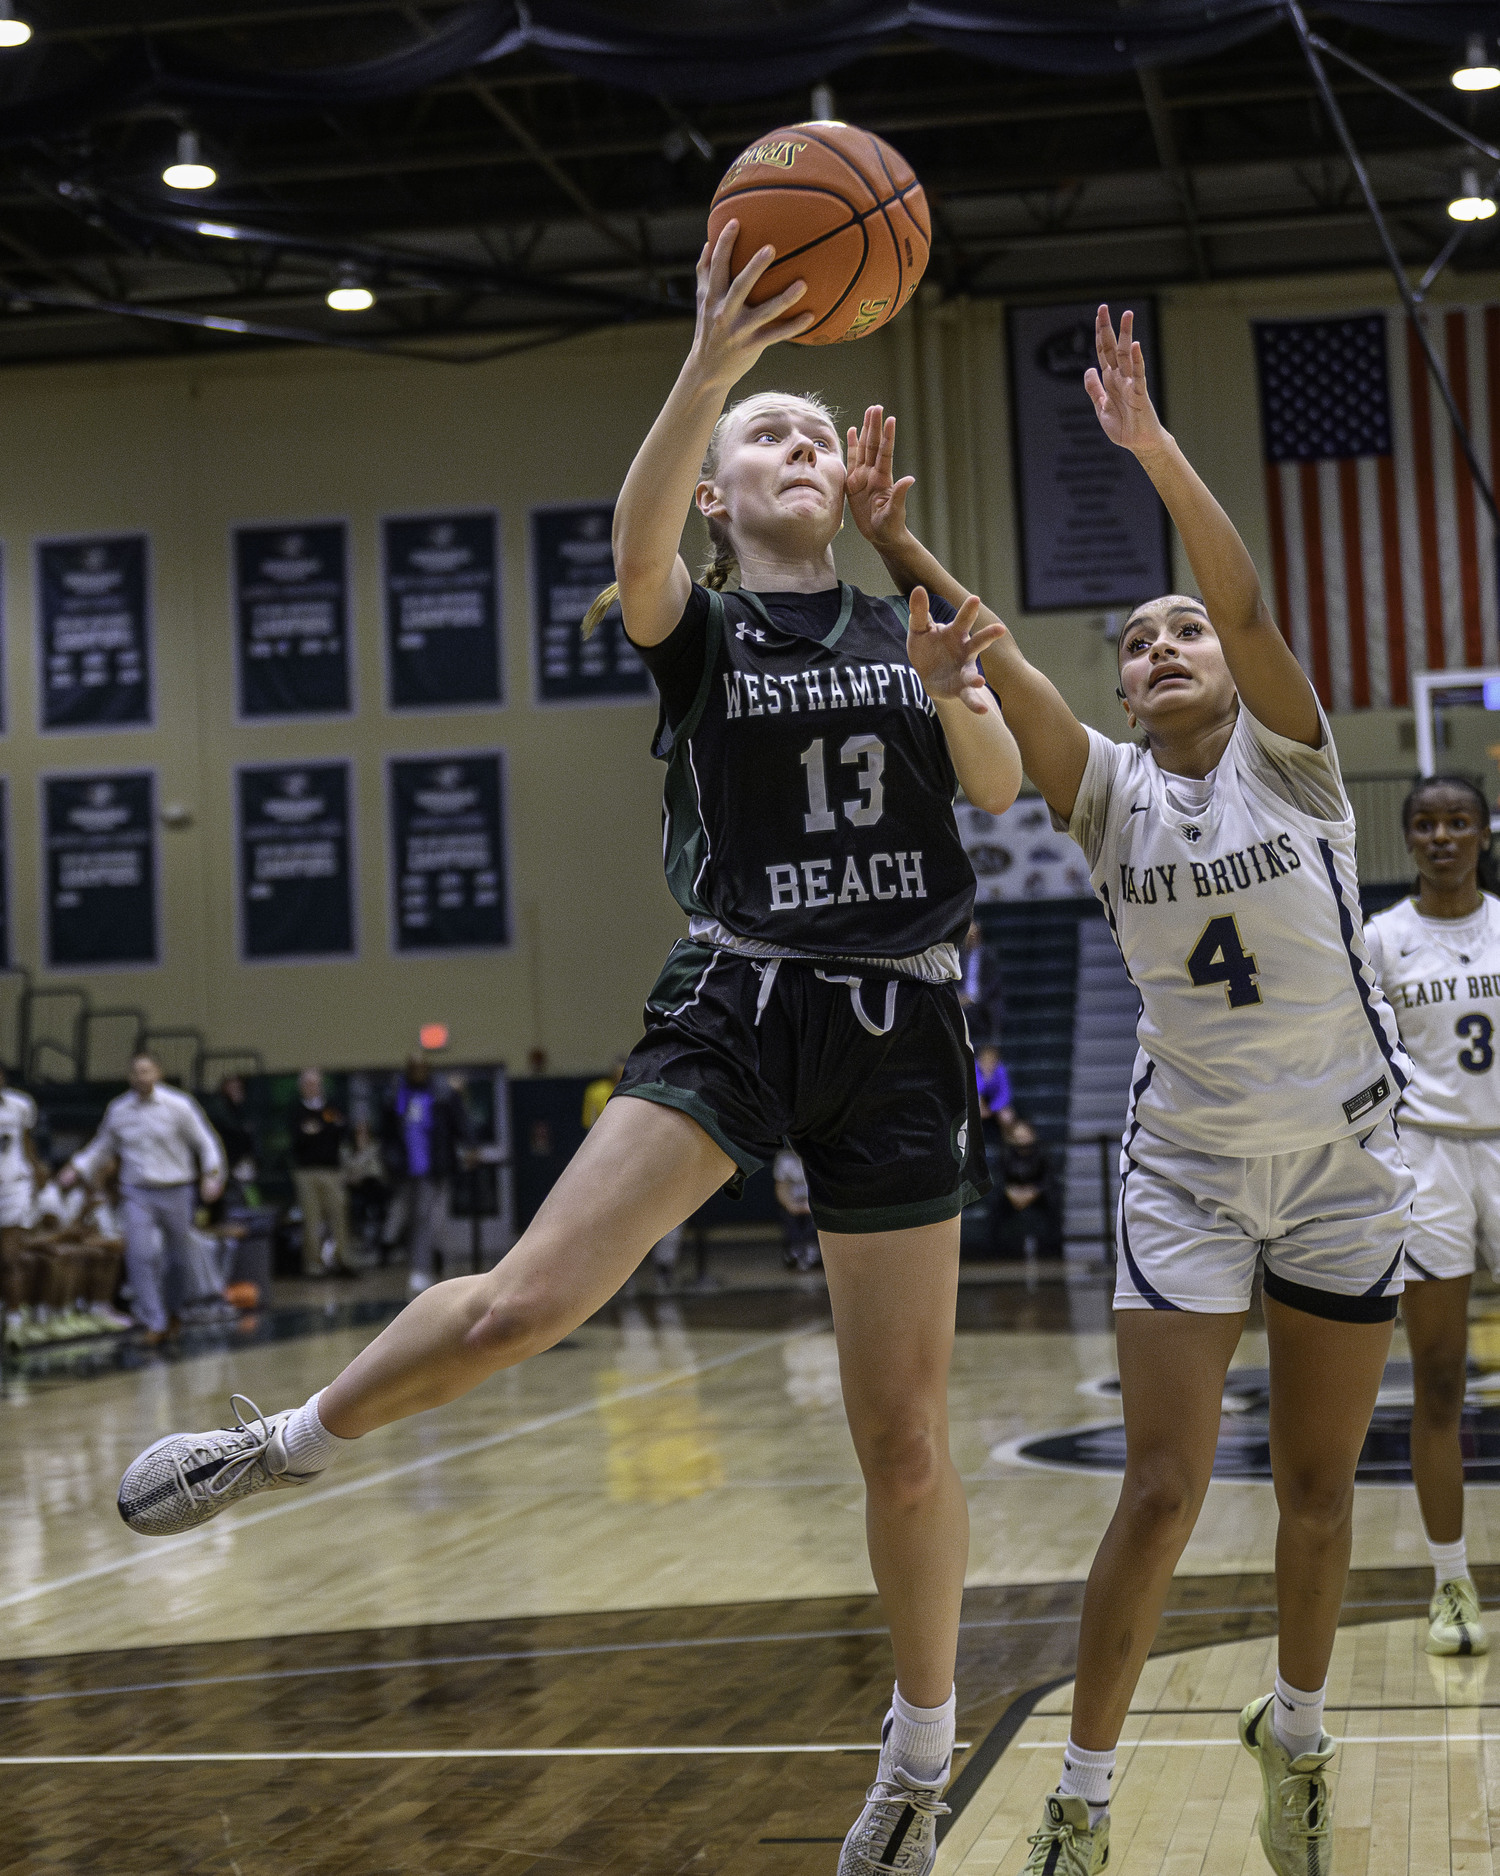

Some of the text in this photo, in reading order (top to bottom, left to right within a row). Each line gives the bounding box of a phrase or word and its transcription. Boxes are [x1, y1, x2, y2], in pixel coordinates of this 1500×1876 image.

[800, 734, 885, 833] 13
[765, 852, 928, 911] BEACH
[1190, 832, 1301, 898] BRUINS
[1184, 911, 1263, 1010] 4
[1401, 978, 1457, 1008] LADY
[1455, 1012, 1495, 1075] 3
[1377, 1086, 1384, 1097] S
